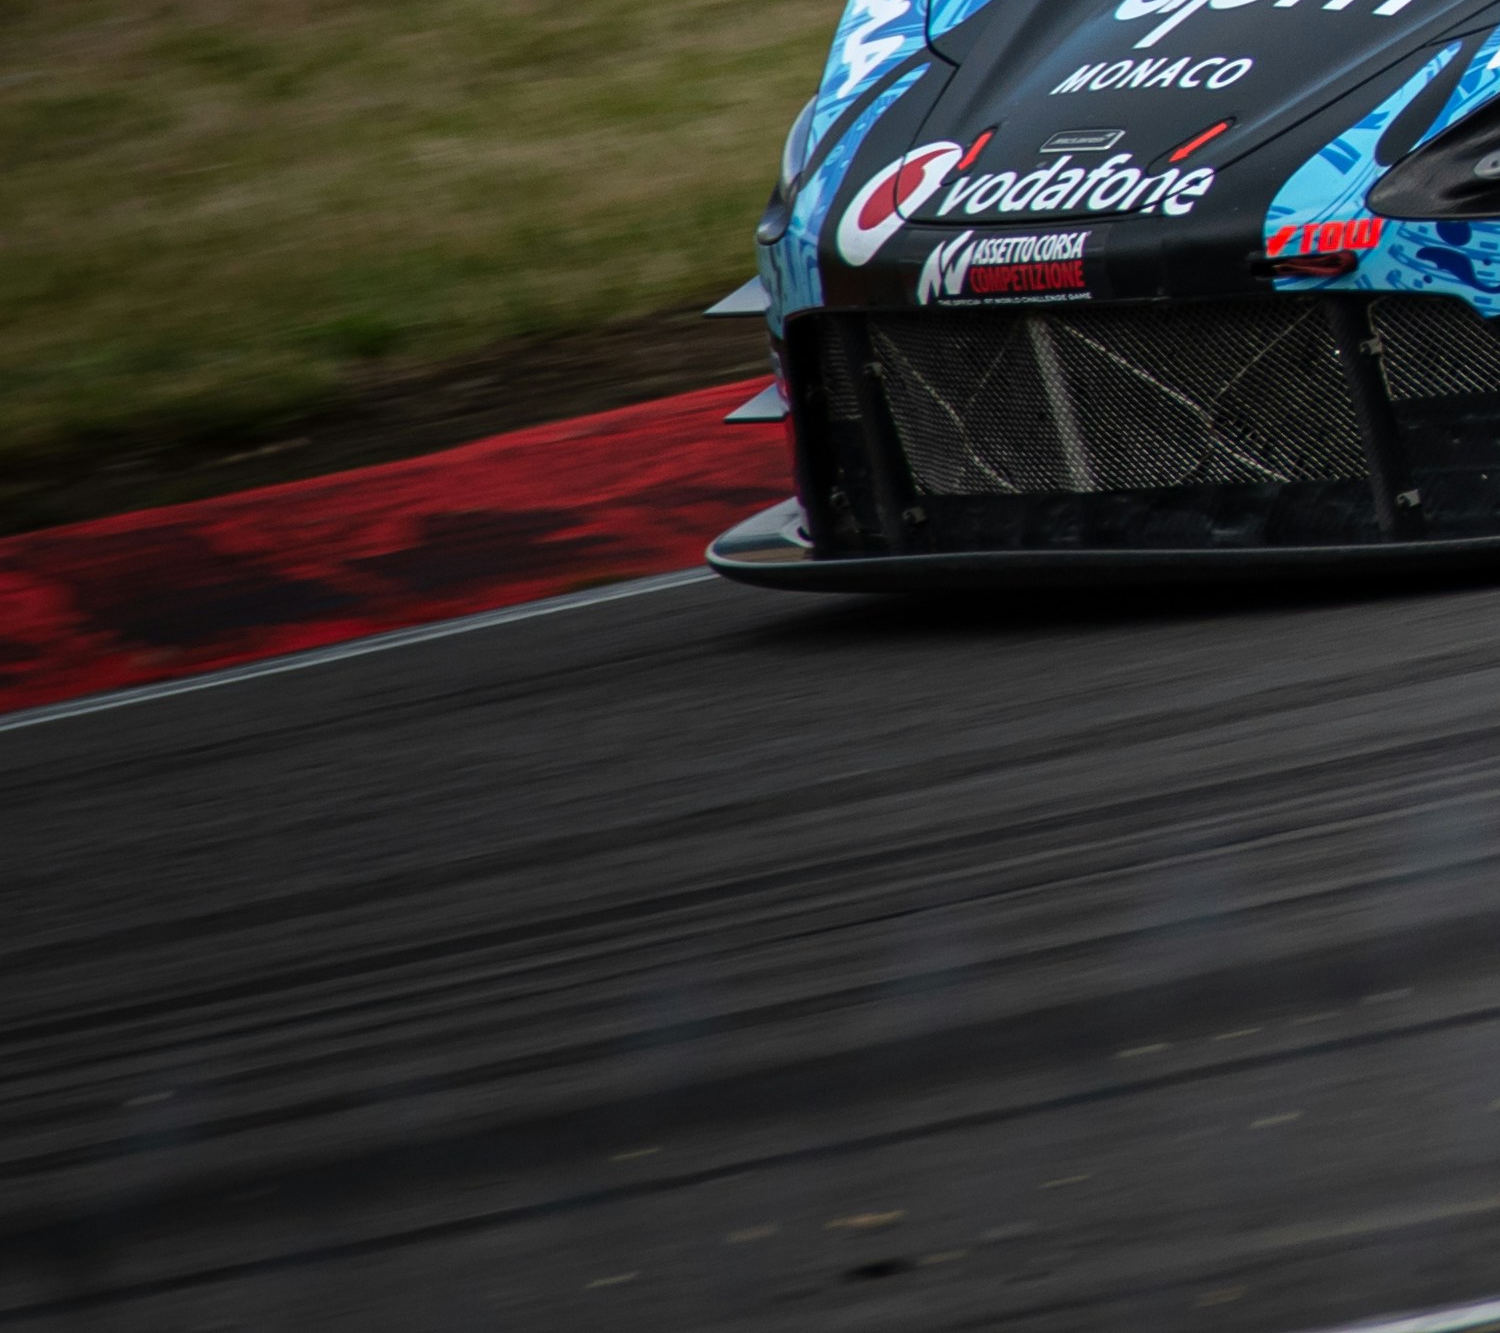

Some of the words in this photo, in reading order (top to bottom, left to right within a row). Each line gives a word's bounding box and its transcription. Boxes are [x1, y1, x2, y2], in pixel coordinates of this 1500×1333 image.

[1049, 57, 1254, 96] MONACO
[937, 154, 1215, 216] vodafone
[972, 236, 1034, 264] ASSETTO
[1034, 232, 1086, 261] CORSA
[1300, 217, 1383, 252] TOW
[970, 260, 1086, 294] COMPETIZIONE
